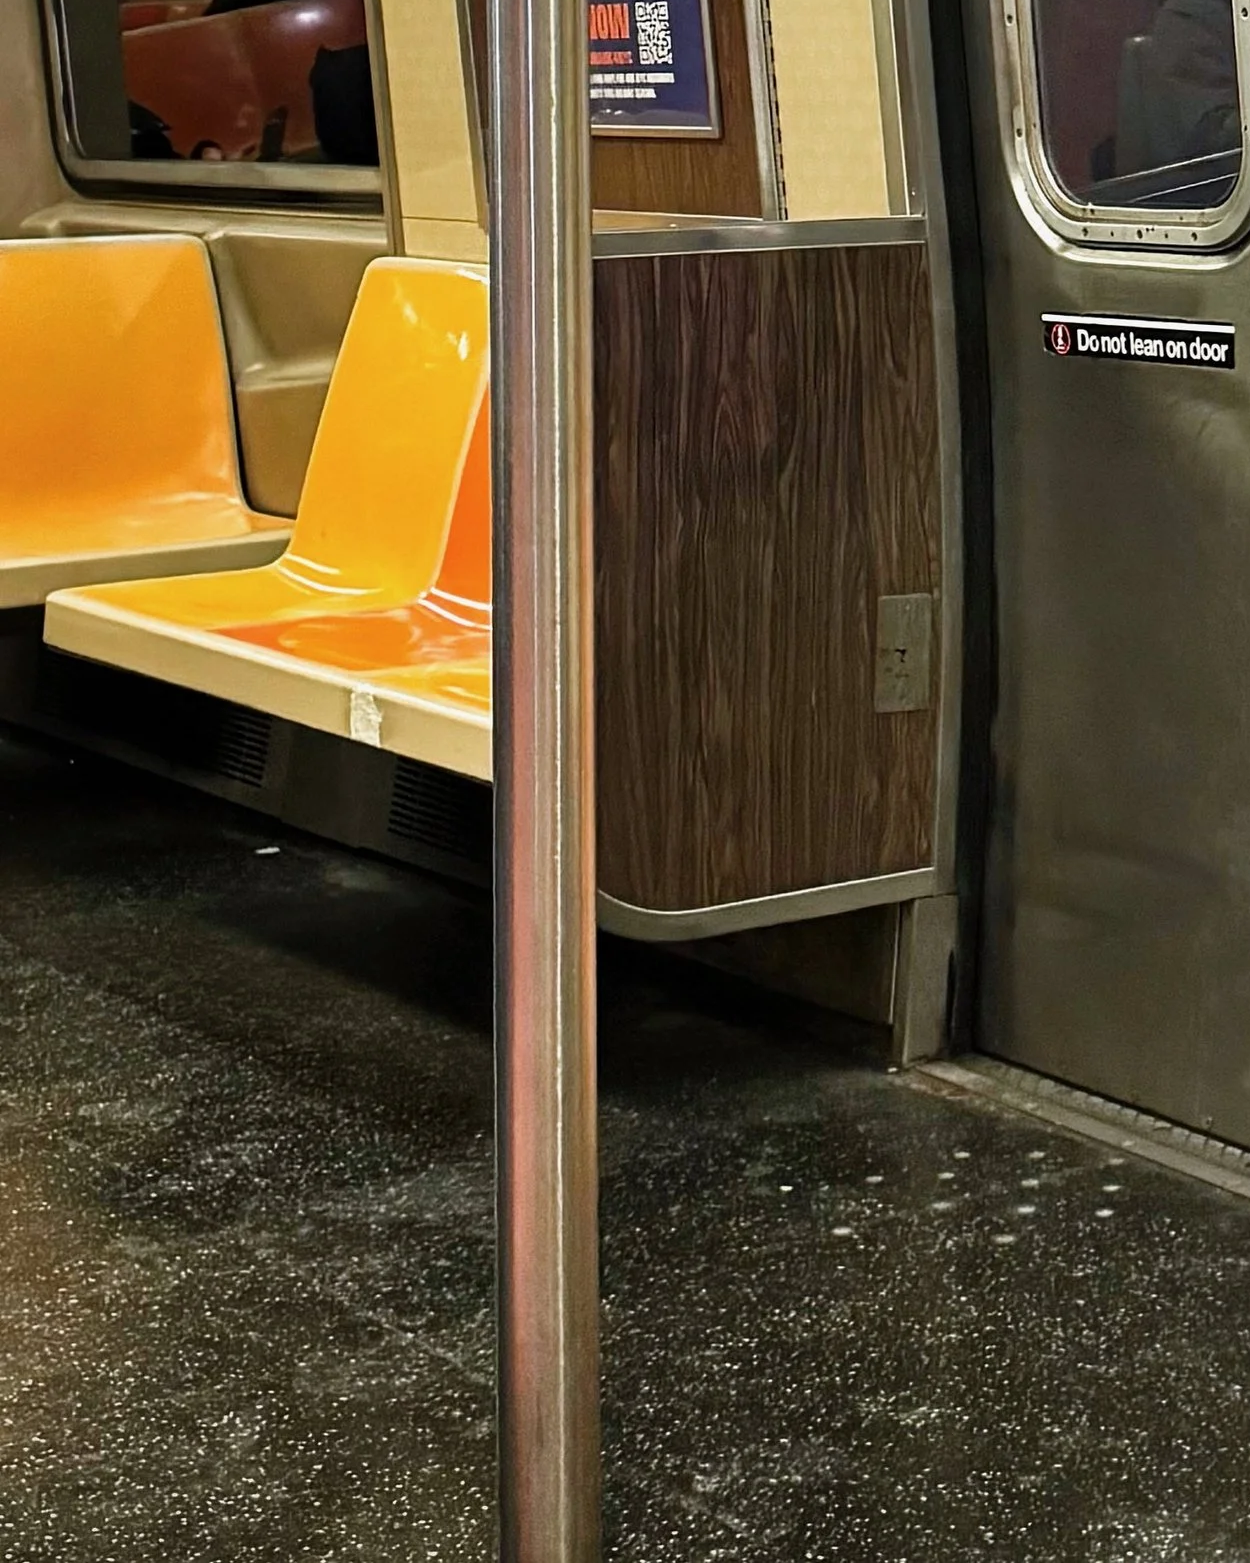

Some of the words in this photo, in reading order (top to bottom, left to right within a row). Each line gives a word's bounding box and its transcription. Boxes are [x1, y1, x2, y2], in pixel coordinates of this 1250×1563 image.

[1076, 329, 1100, 352] Do
[1100, 332, 1128, 354] not
[1129, 332, 1164, 358] lean
[1165, 339, 1188, 359] on
[1189, 336, 1229, 362] door
